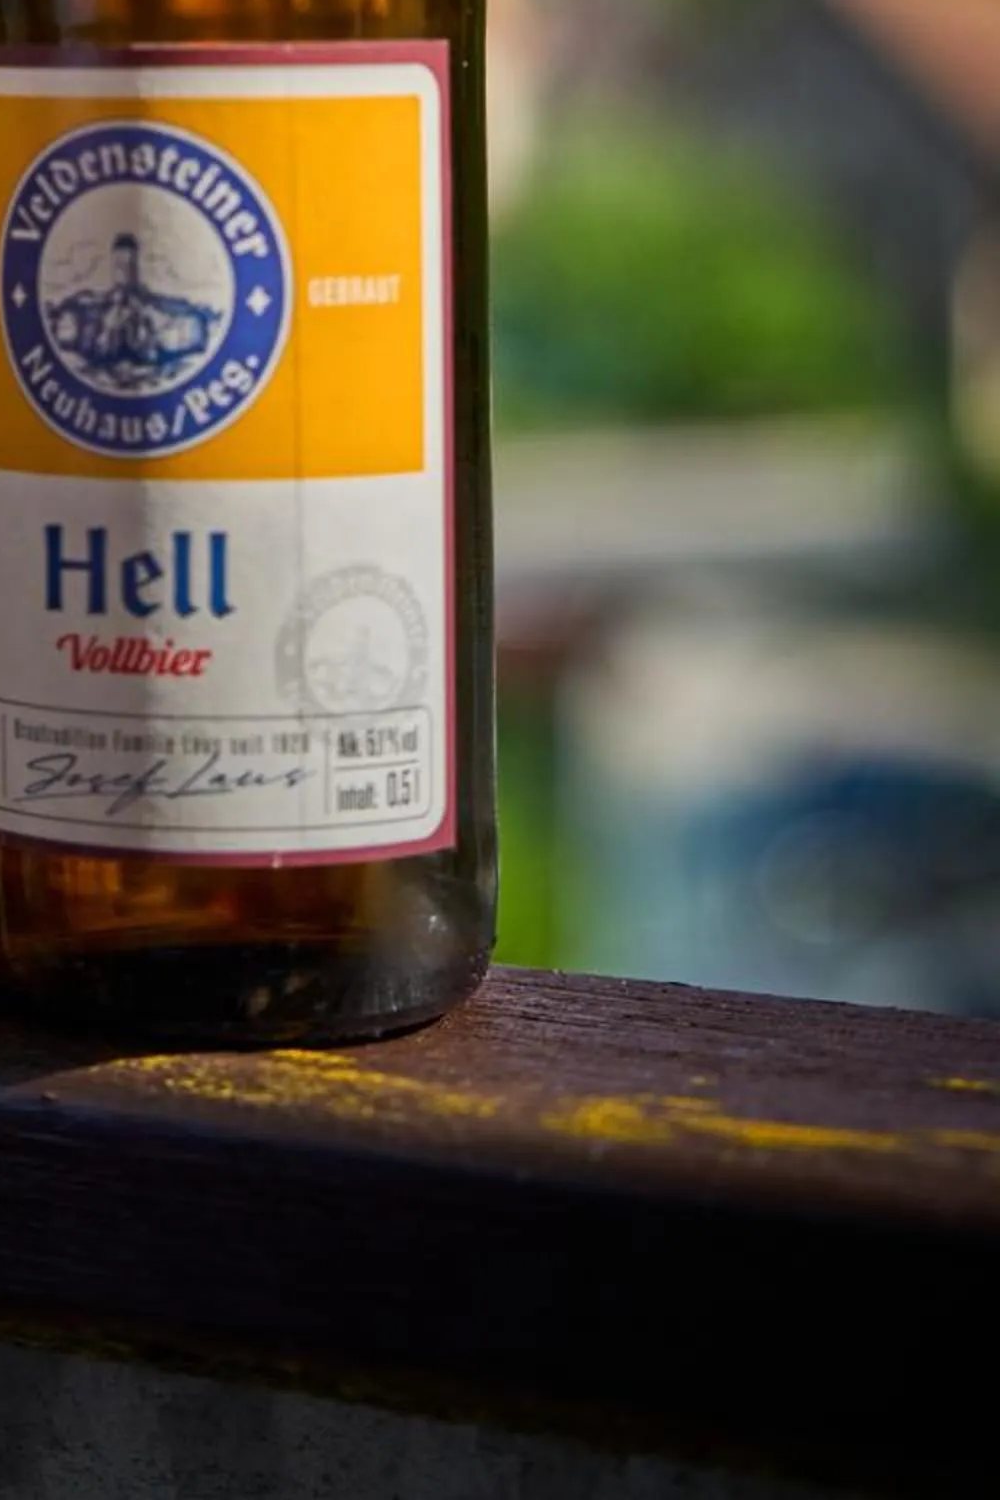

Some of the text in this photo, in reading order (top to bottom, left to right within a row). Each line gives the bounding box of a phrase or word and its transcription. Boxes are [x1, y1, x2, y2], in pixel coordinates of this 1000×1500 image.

[11, 141, 268, 261] Veldensteiner
[21, 344, 261, 444] Neuhaus/Peg.
[43, 523, 237, 620] Hell
[56, 633, 212, 678] Vollbier
